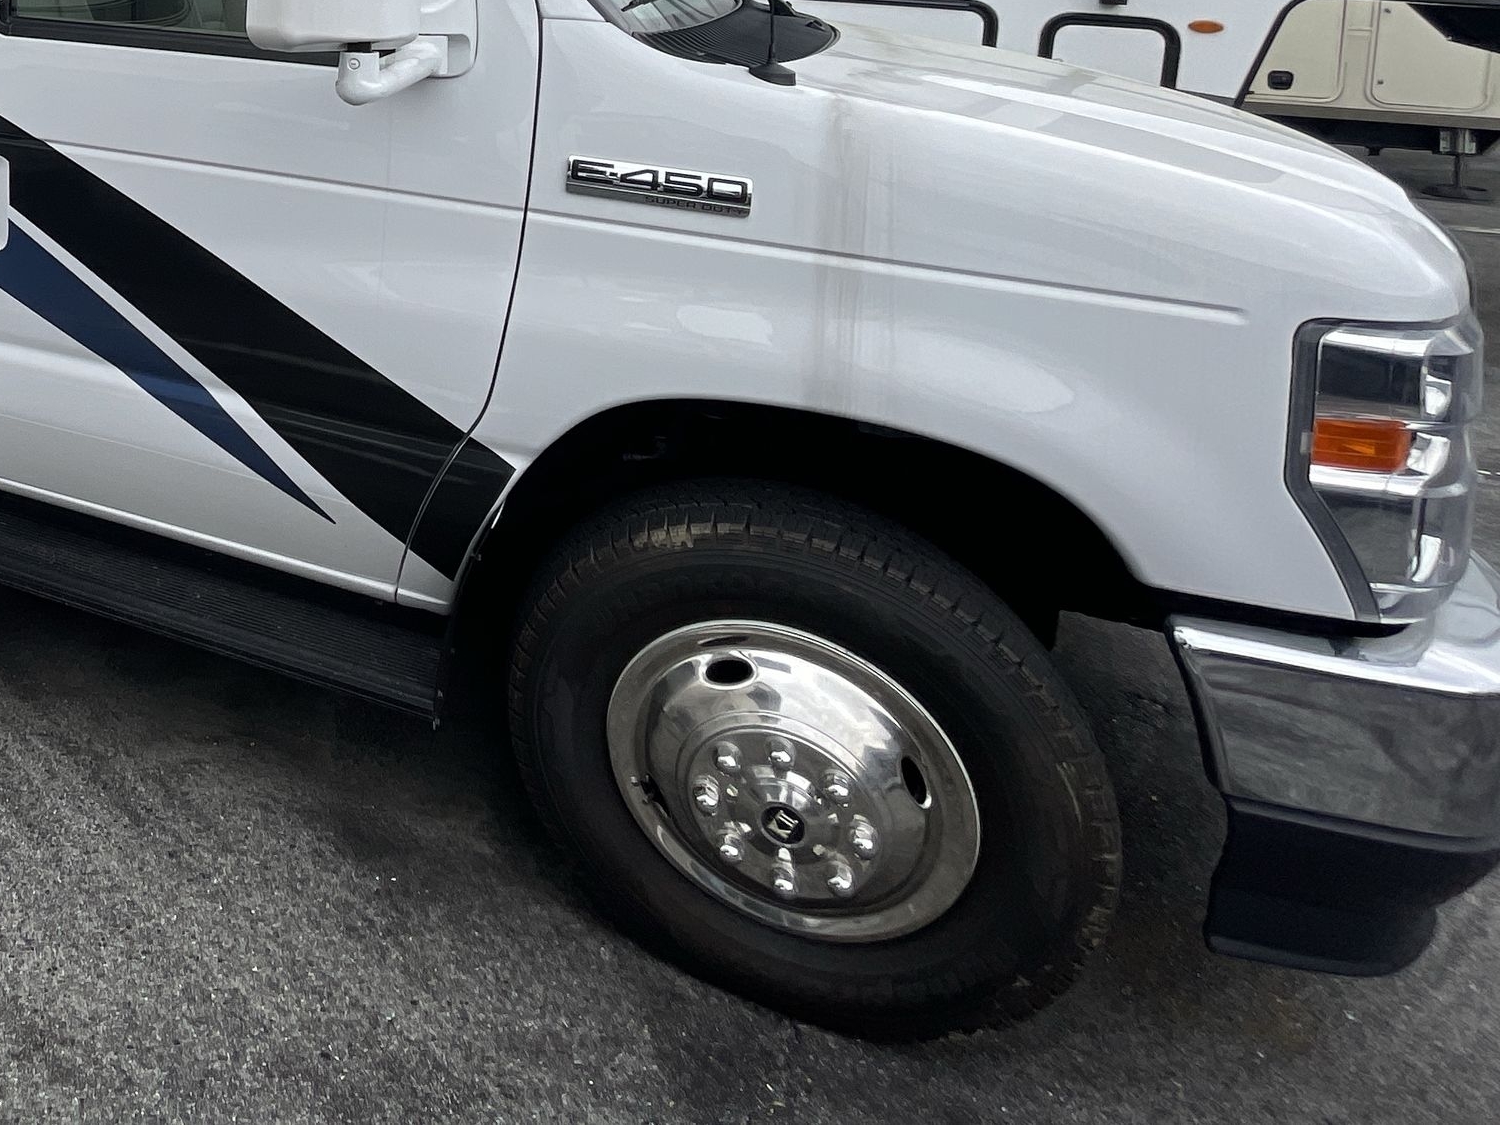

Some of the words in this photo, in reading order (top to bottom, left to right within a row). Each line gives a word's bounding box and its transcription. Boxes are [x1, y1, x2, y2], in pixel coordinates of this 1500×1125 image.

[571, 159, 748, 203] E-450
[645, 195, 697, 209] SUPER
[700, 203, 750, 215] DUTY
